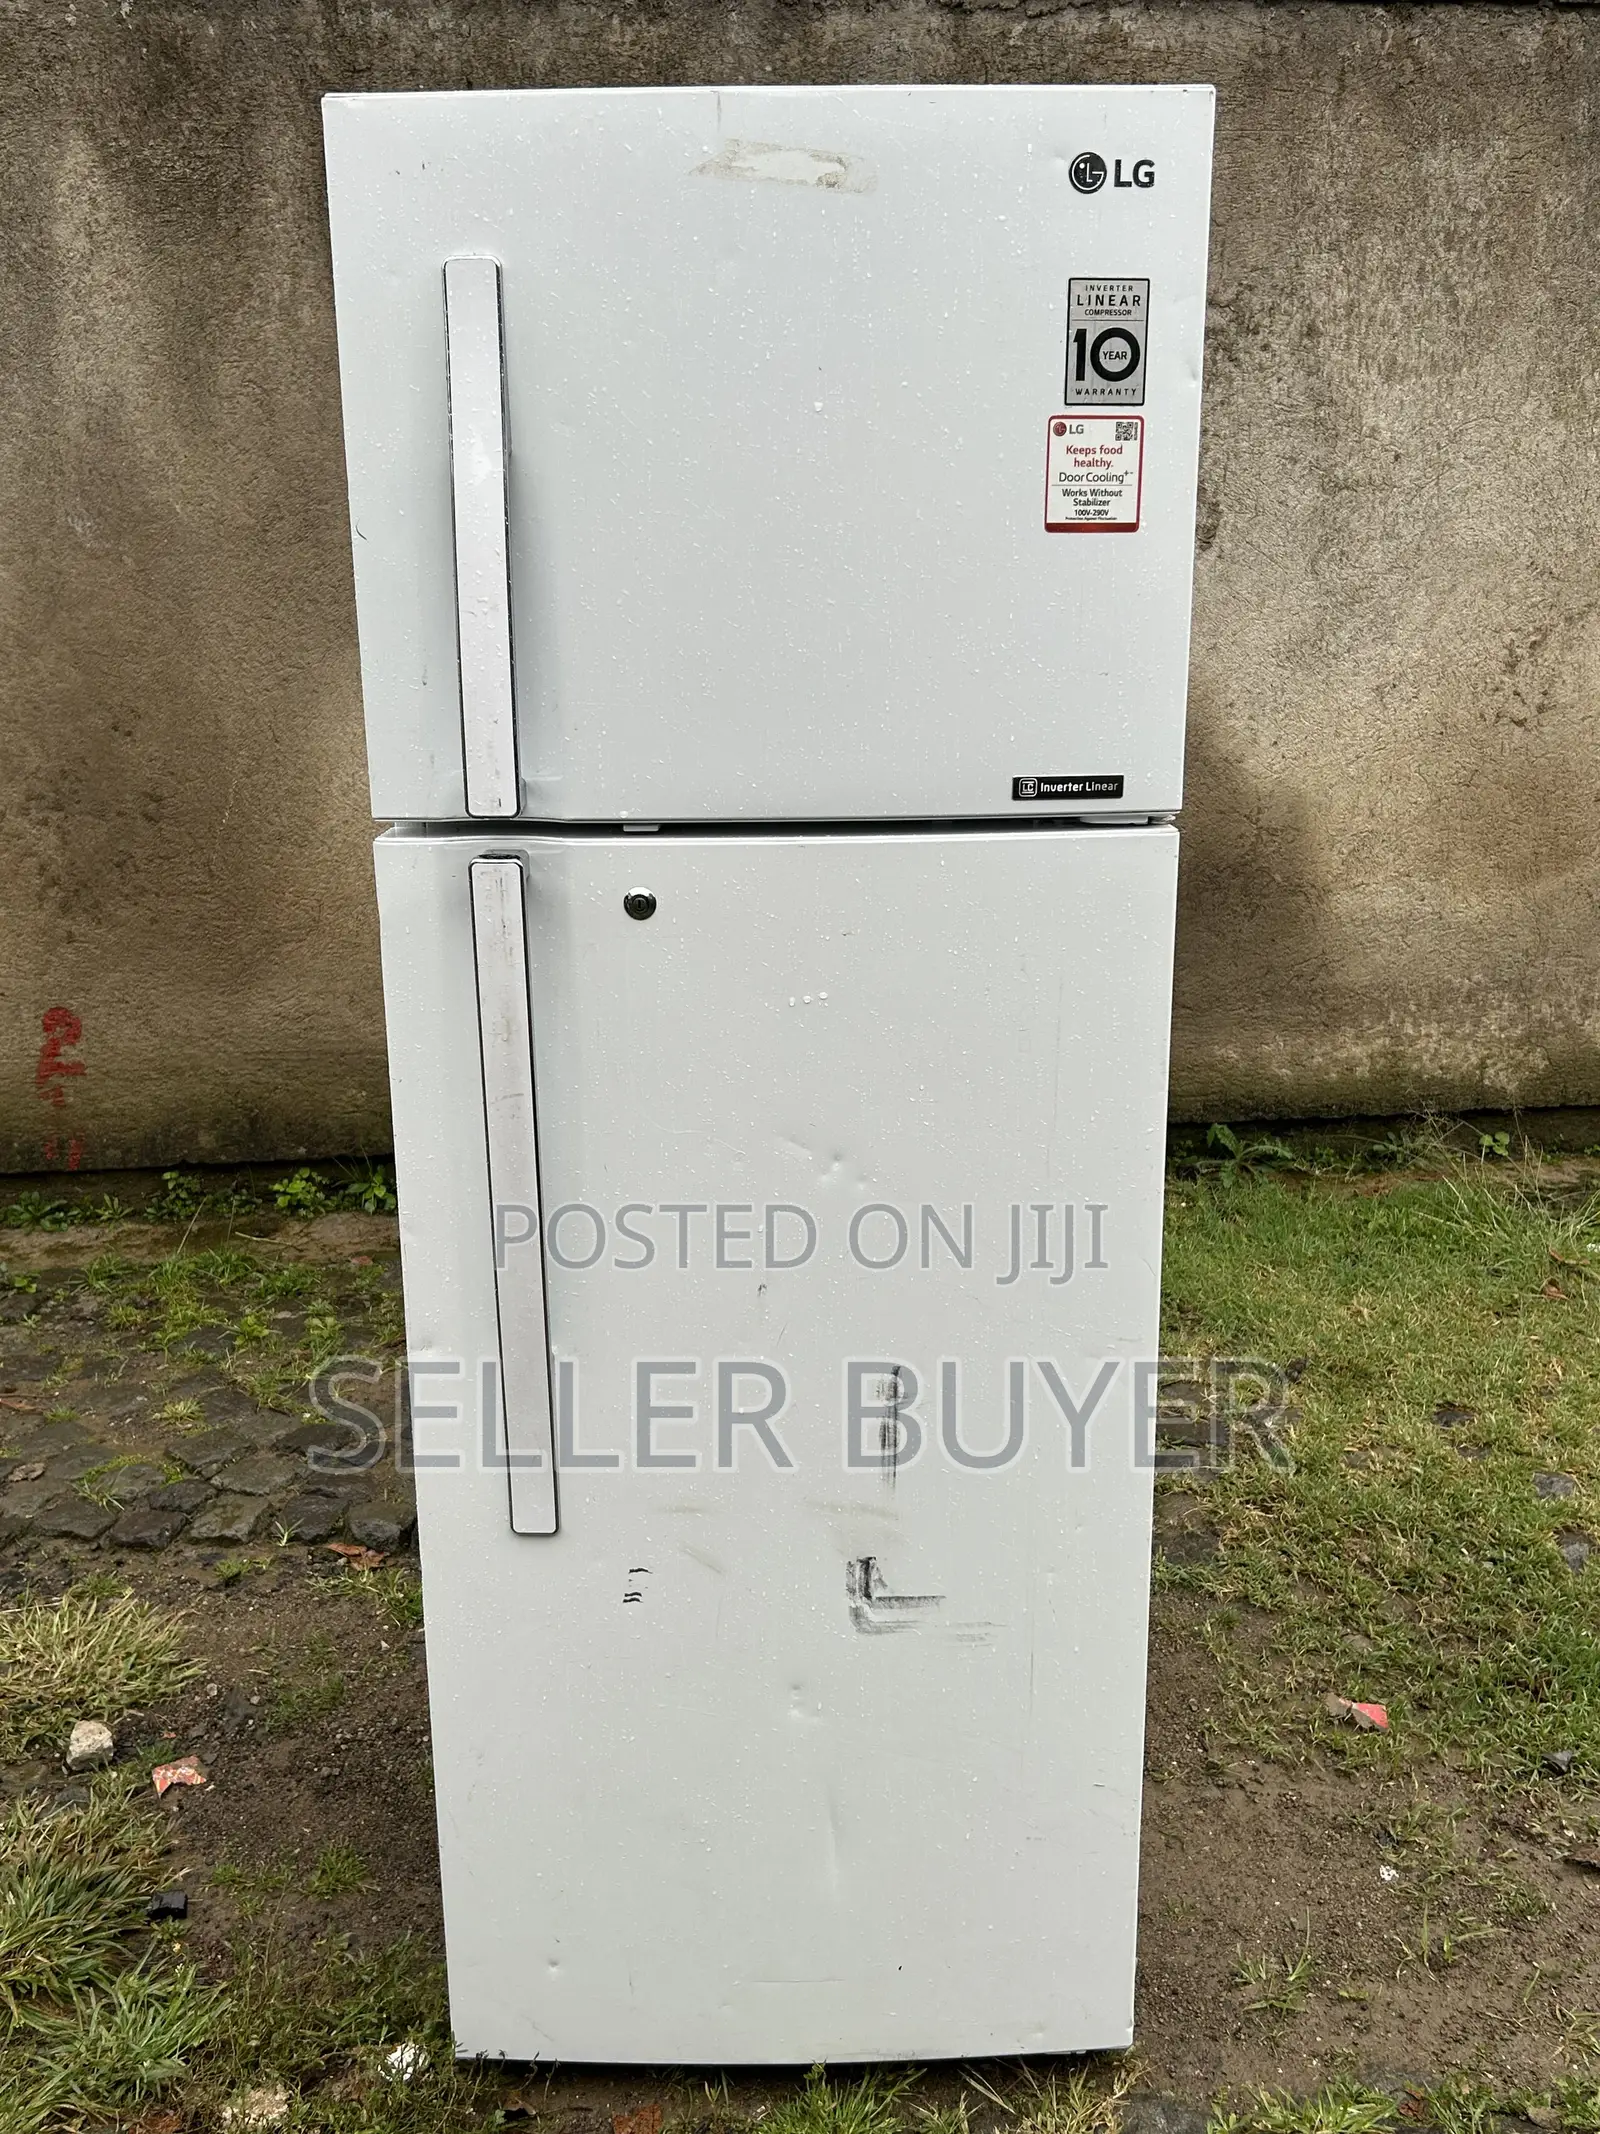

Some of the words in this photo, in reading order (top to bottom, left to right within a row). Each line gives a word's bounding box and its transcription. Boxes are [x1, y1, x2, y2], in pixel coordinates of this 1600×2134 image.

[1113, 158, 1155, 188] LG
[1085, 284, 1134, 292] INVERTER
[1077, 294, 1141, 306] LINEAR
[1084, 308, 1132, 316] COMPRESSOR
[1073, 327, 1141, 382] 10
[1102, 351, 1128, 360] YEAR
[1075, 388, 1137, 396] WARRANTY
[1069, 424, 1084, 435] LG
[1066, 444, 1097, 457] Keeps
[1099, 444, 1123, 455] food
[1073, 457, 1114, 470] healthy.
[1061, 488, 1088, 497] Works
[1089, 488, 1123, 497] Without
[1073, 498, 1111, 507] Stabilizer
[1040, 782, 1083, 792] Inverter
[1085, 781, 1118, 791] Linear
